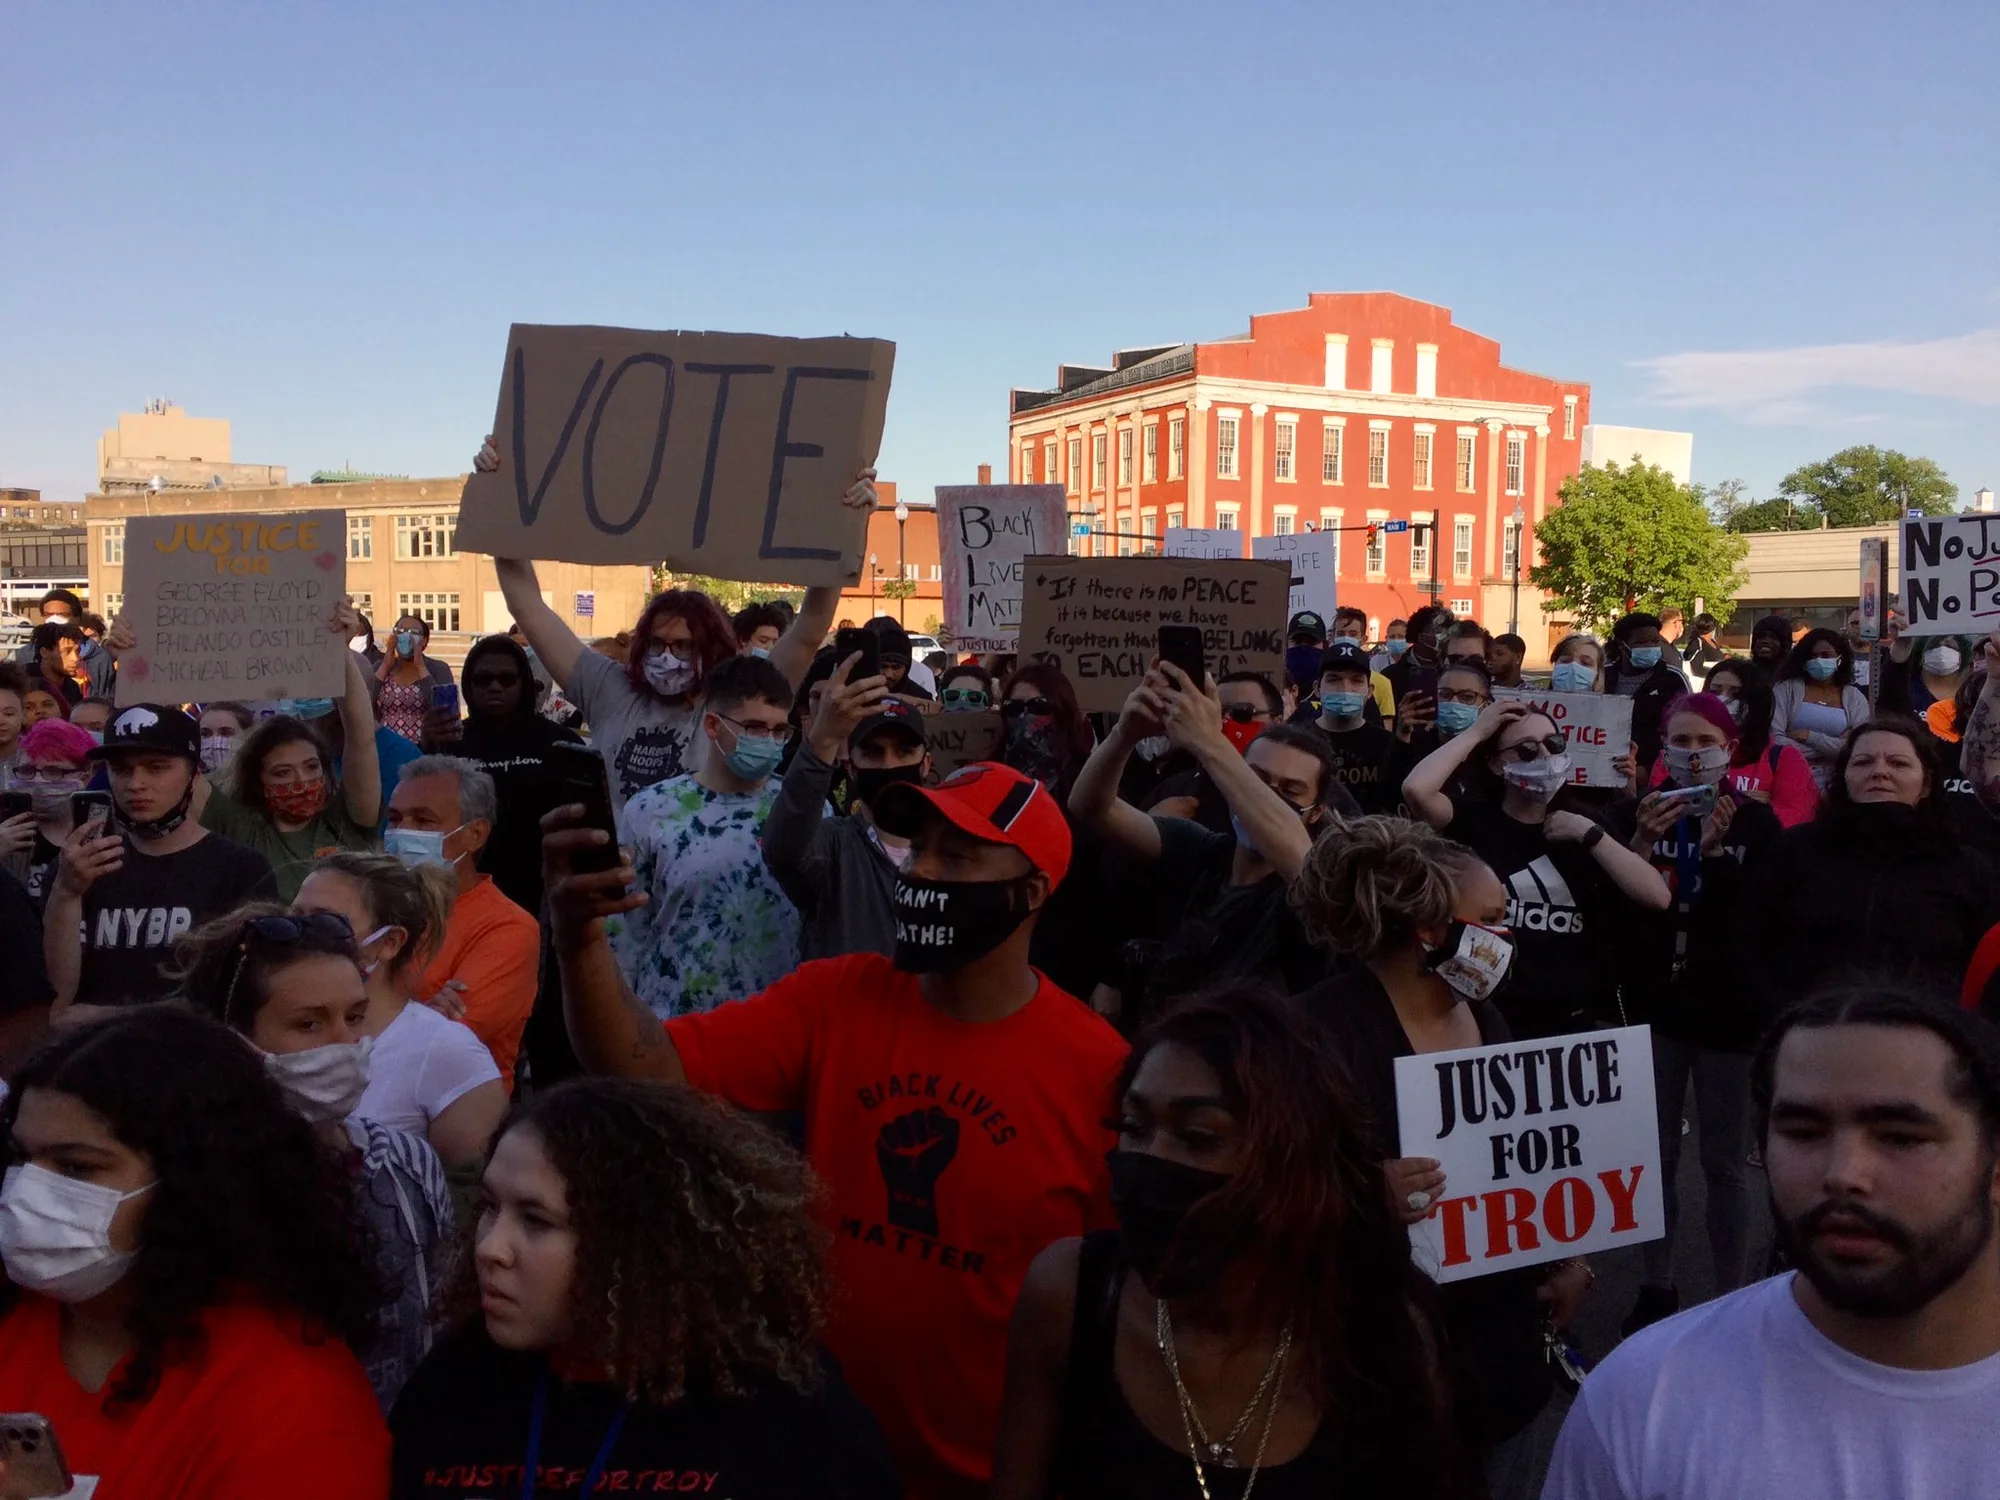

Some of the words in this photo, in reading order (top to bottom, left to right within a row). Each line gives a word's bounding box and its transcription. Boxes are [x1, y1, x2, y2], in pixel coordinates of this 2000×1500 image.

[513, 346, 875, 561] VOTE
[154, 520, 321, 554] JUSTICE
[1184, 528, 1211, 543] IS
[1273, 535, 1298, 551] IS
[214, 554, 272, 576] FOR
[156, 581, 245, 604] GEORGE
[253, 579, 321, 604] FLOYD
[1086, 578, 1134, 600] there
[1139, 577, 1155, 598] is
[1158, 583, 1178, 602] no
[1182, 576, 1258, 604] PEACE
[157, 605, 246, 628] BREONNA
[257, 604, 325, 625] TAYLOR
[1057, 605, 1069, 622] it
[1073, 604, 1087, 621] is
[1092, 606, 1151, 623] because
[1159, 608, 1184, 623] we
[1189, 605, 1228, 626] have
[155, 631, 242, 656] PHILANDO
[952, 636, 1007, 651] JUSTICE
[1044, 626, 1120, 654] forgotten
[1123, 631, 1158, 649] that
[1203, 629, 1283, 654] BELONG
[151, 660, 235, 683] MICHEAL
[246, 654, 315, 682] BROWN
[1078, 652, 1145, 678] EACH
[924, 729, 967, 752] NLY
[1561, 725, 1607, 746] TICE
[1502, 899, 1584, 934] didas
[1435, 1040, 1622, 1140] JUSTICE
[857, 1072, 943, 1111] BLACK
[949, 1080, 1017, 1146] LIVES
[1489, 1123, 1583, 1181] FOR
[1424, 1165, 1645, 1267] TROY
